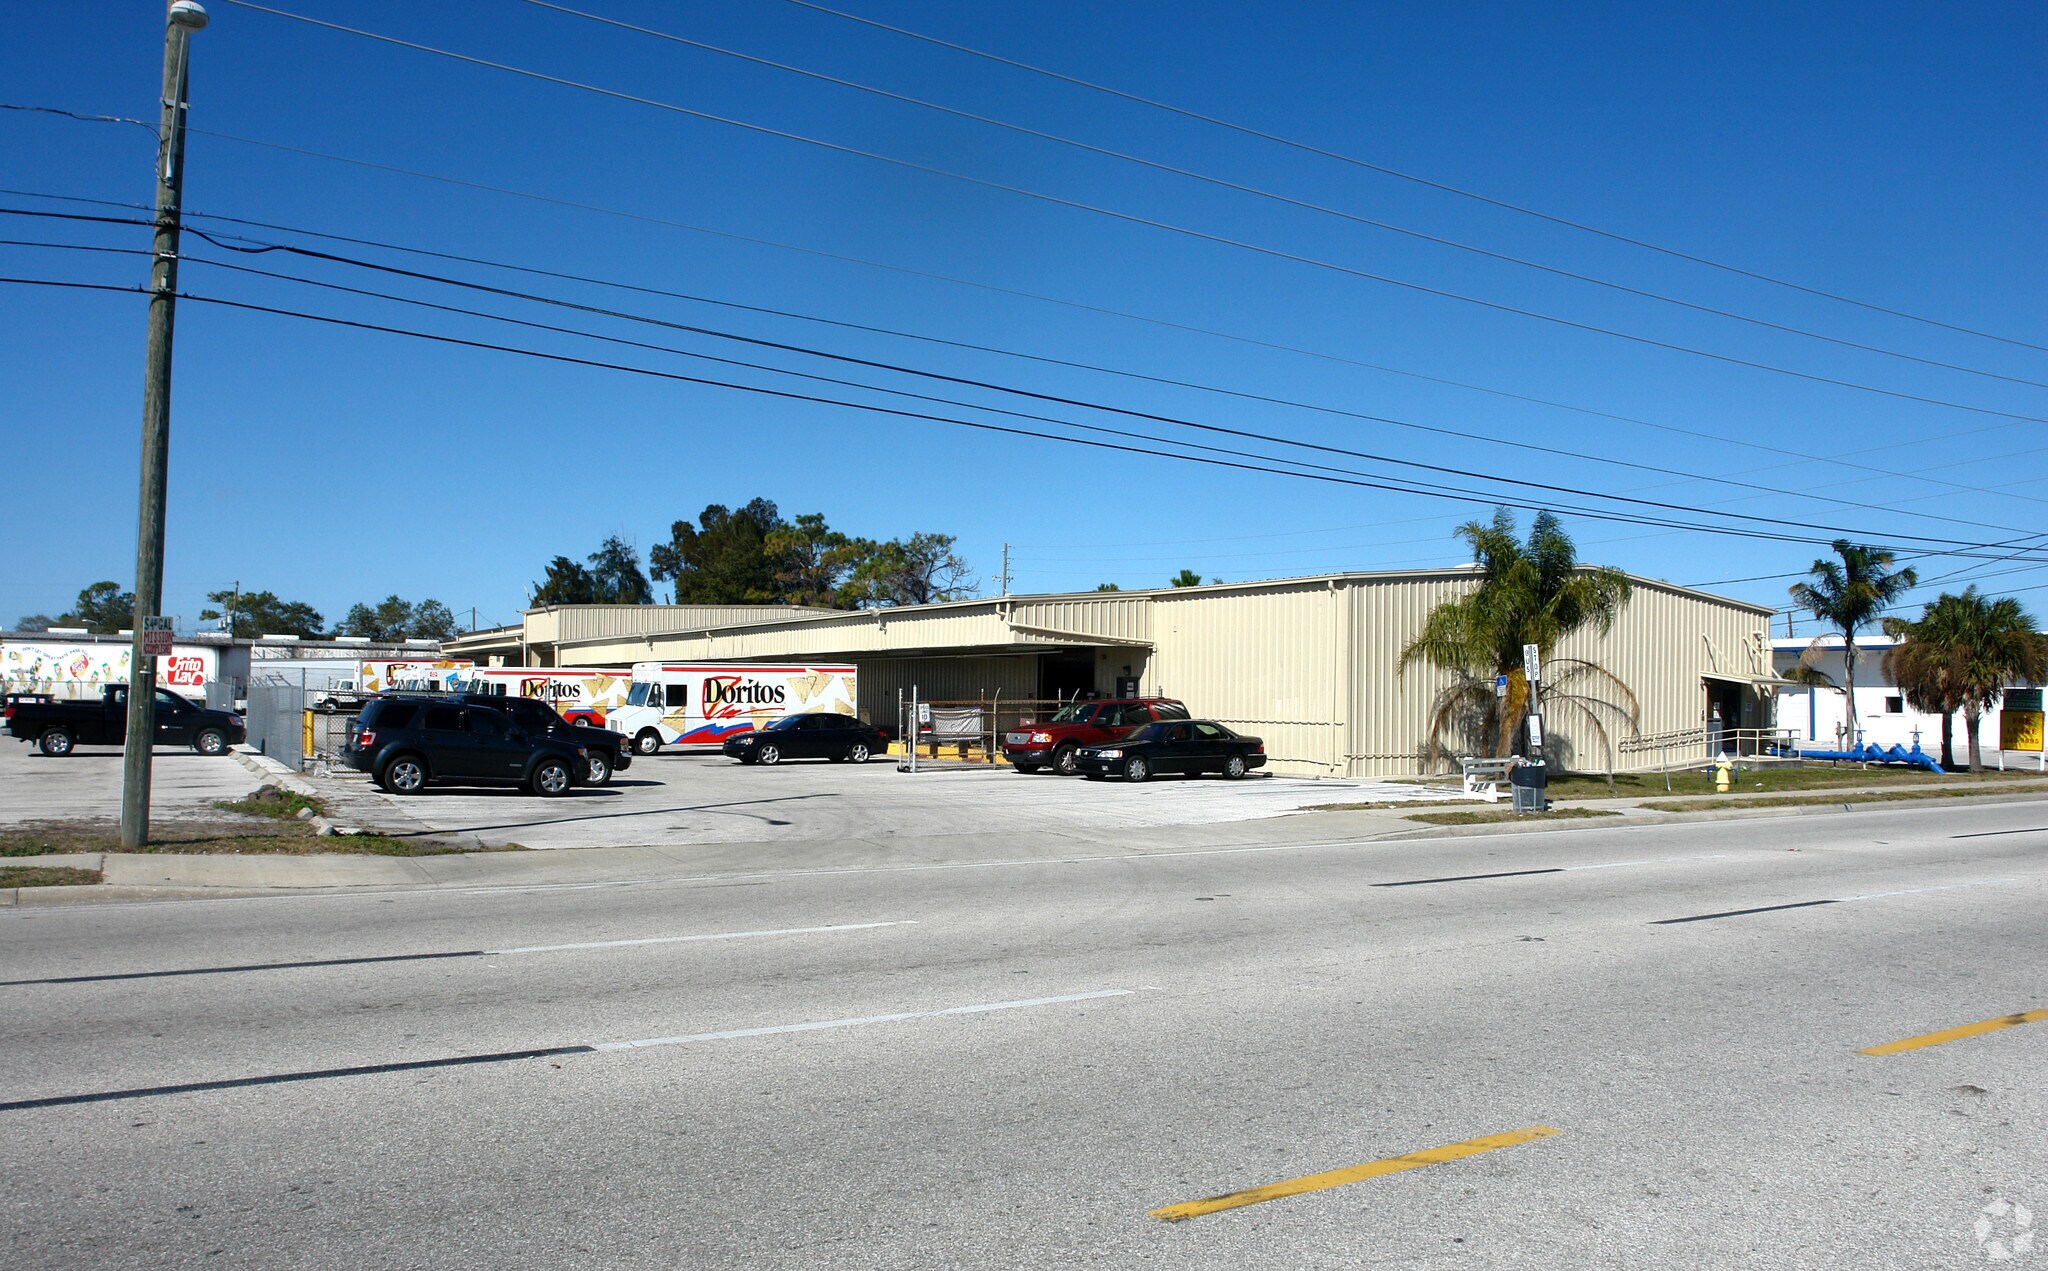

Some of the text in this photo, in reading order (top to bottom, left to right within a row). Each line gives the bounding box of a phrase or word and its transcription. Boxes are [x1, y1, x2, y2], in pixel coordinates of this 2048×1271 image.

[144, 631, 173, 643] MISSION
[520, 678, 581, 698] Doritos
[703, 677, 786, 704] Doritos
